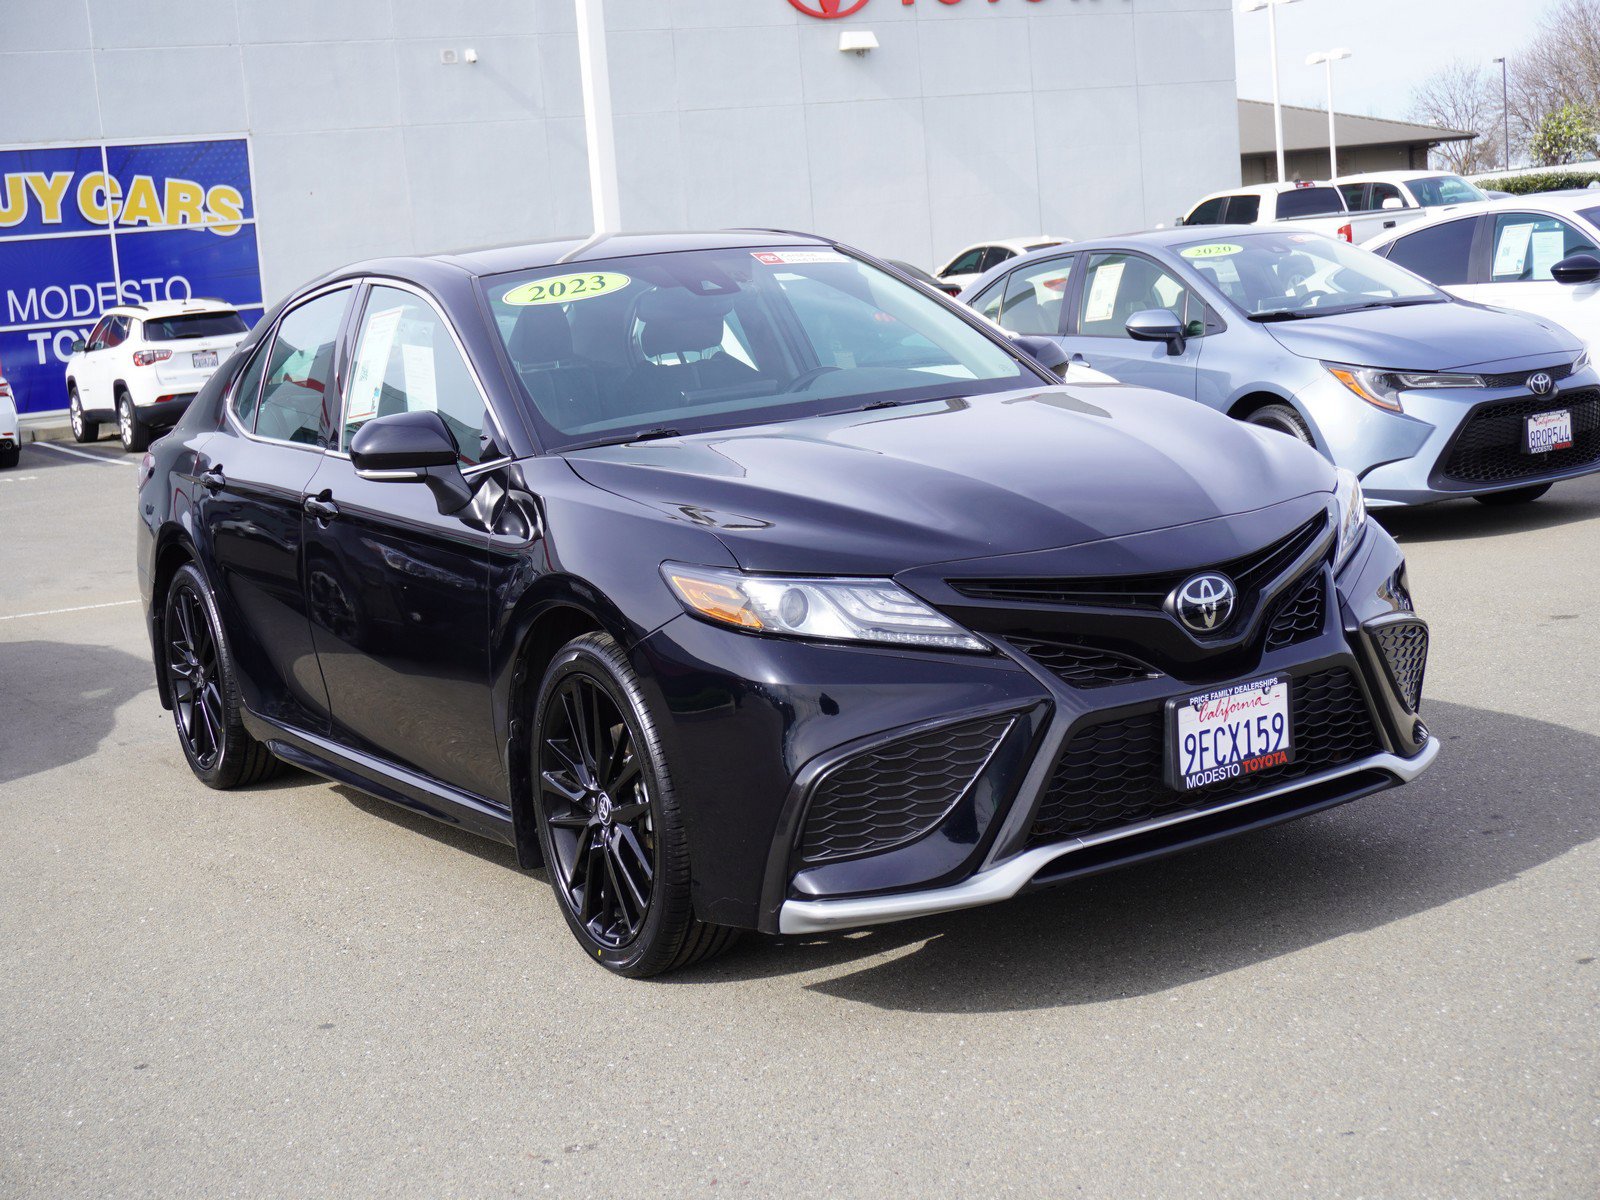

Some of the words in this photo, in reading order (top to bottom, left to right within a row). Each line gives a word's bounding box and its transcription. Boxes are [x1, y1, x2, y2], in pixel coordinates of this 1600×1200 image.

[77, 171, 244, 236] CARS
[1195, 246, 1231, 256] 2020
[7, 275, 192, 322] MODESTO
[528, 275, 606, 302] 2023
[1189, 694, 1209, 706] PRICE
[1210, 687, 1233, 700] FAMILY
[1234, 677, 1278, 694] DEALERSHIPS
[1199, 695, 1269, 722] California
[1184, 712, 1284, 775] 9FCX159
[1186, 763, 1240, 789] MODESTO
[1242, 750, 1288, 774] TOYOTA
